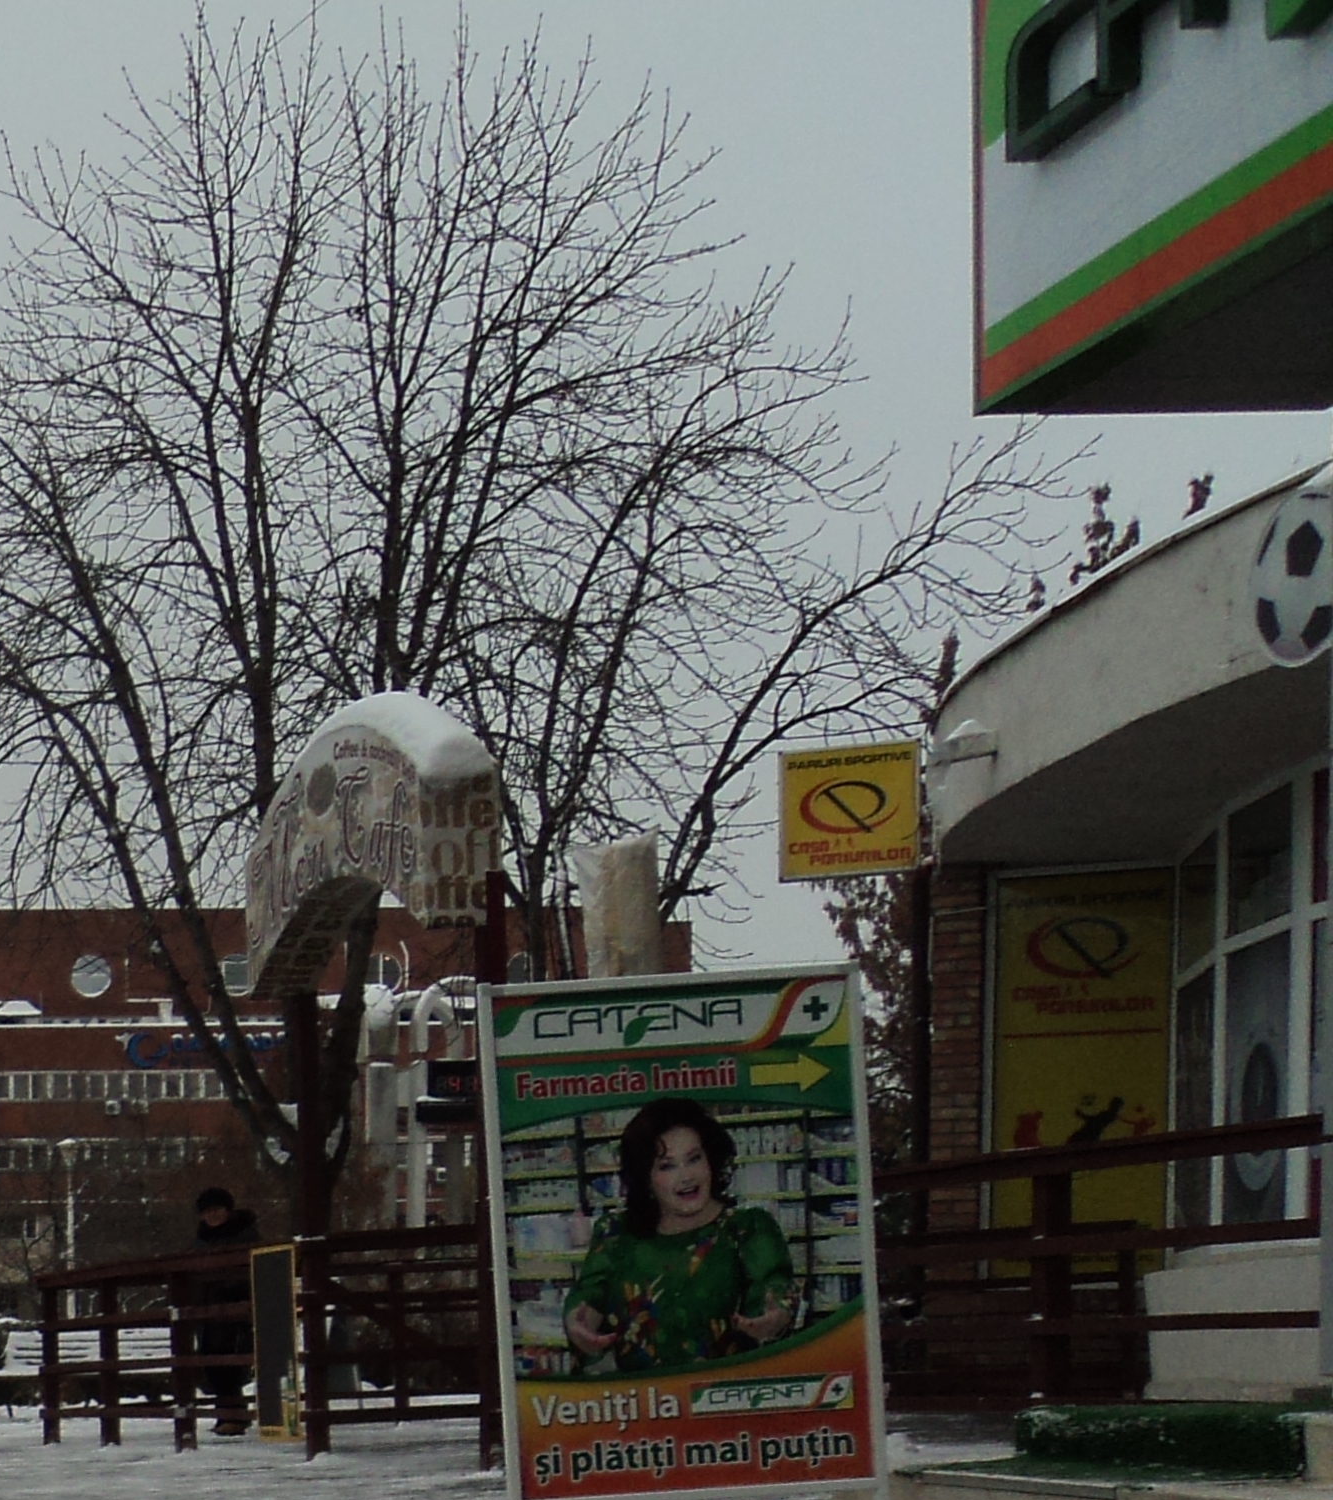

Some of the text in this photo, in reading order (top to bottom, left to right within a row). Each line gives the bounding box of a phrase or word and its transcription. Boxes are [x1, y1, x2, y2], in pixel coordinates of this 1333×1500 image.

[787, 750, 912, 771] PARIURI SPORTIVE
[810, 846, 912, 867] PARIURILOR
[534, 998, 743, 1044] CATENA
[515, 1058, 737, 1100] Farmacia Inimii
[530, 1385, 806, 1431] Veniți la CATENA
[535, 1428, 855, 1485] și plătiți mai puțin
